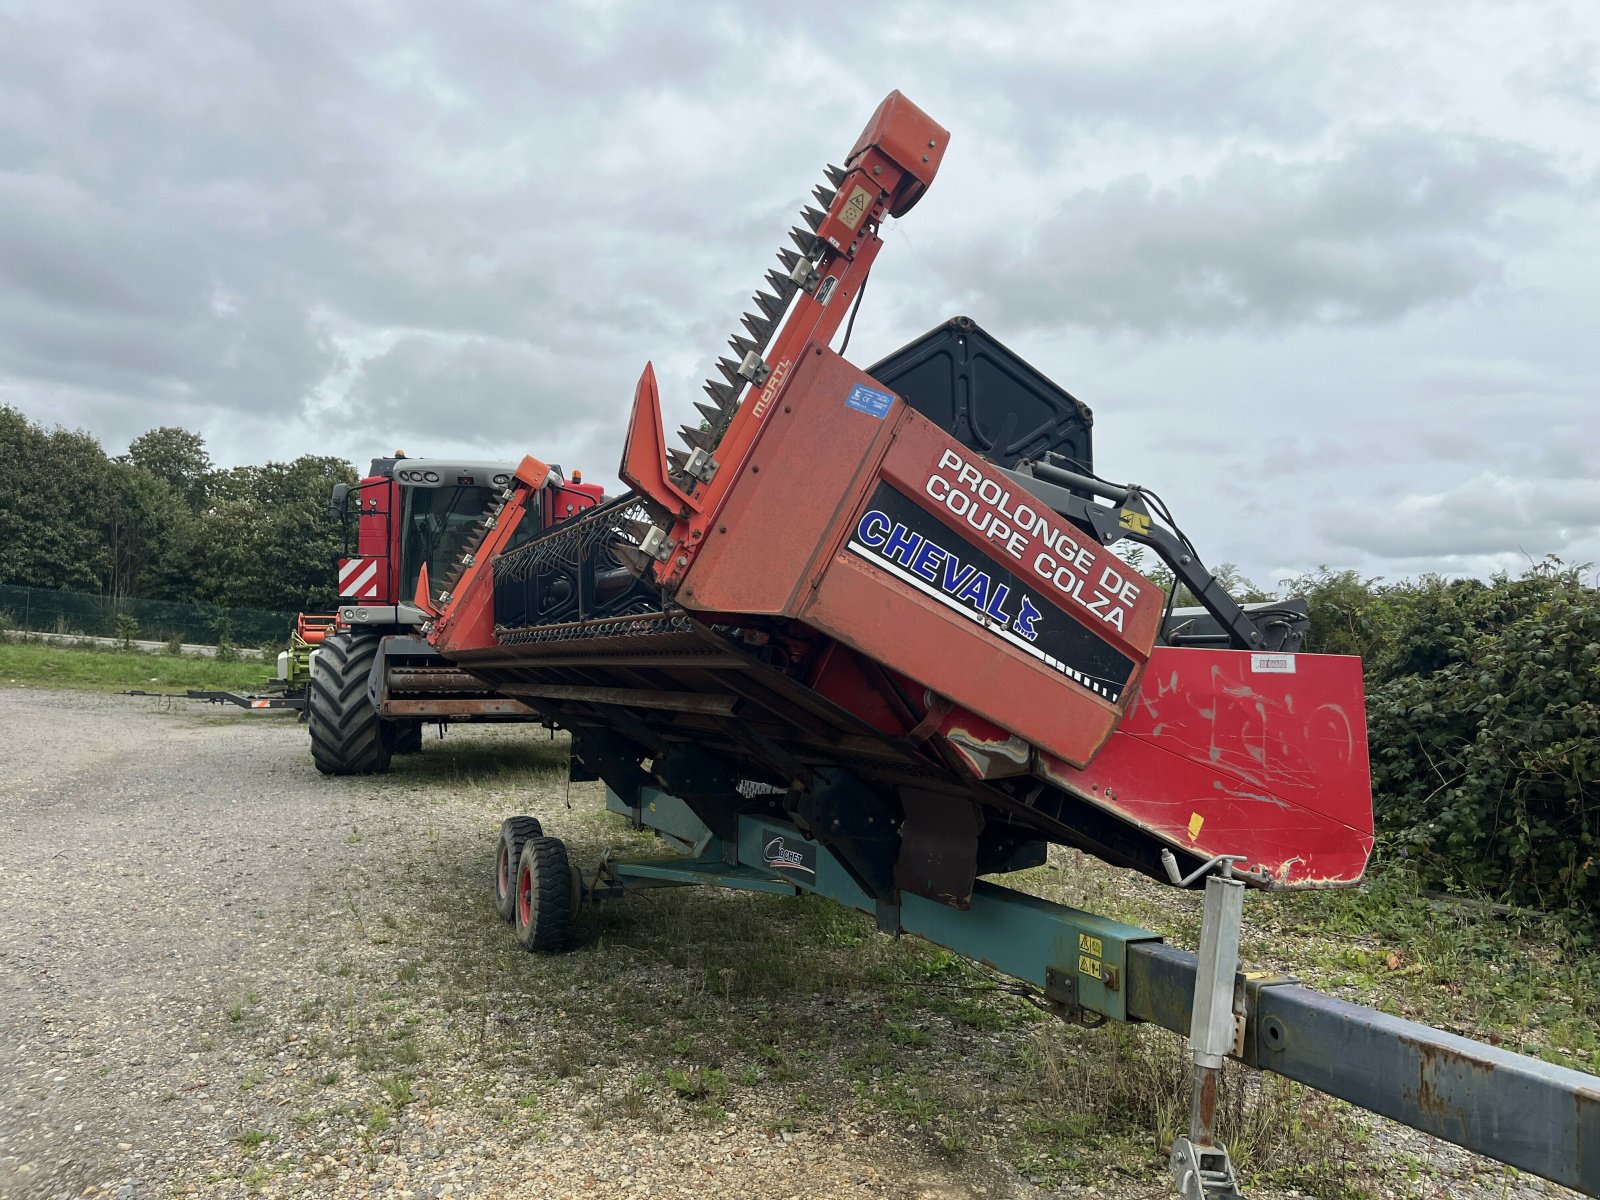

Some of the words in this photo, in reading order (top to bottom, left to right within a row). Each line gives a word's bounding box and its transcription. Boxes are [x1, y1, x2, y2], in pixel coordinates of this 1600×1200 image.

[857, 510, 1010, 624] CHEVAL
[925, 474, 1029, 559] COUPE
[1033, 551, 1125, 633] COLZA
[937, 448, 1096, 575] PROLONGE
[1098, 566, 1141, 608] DE
